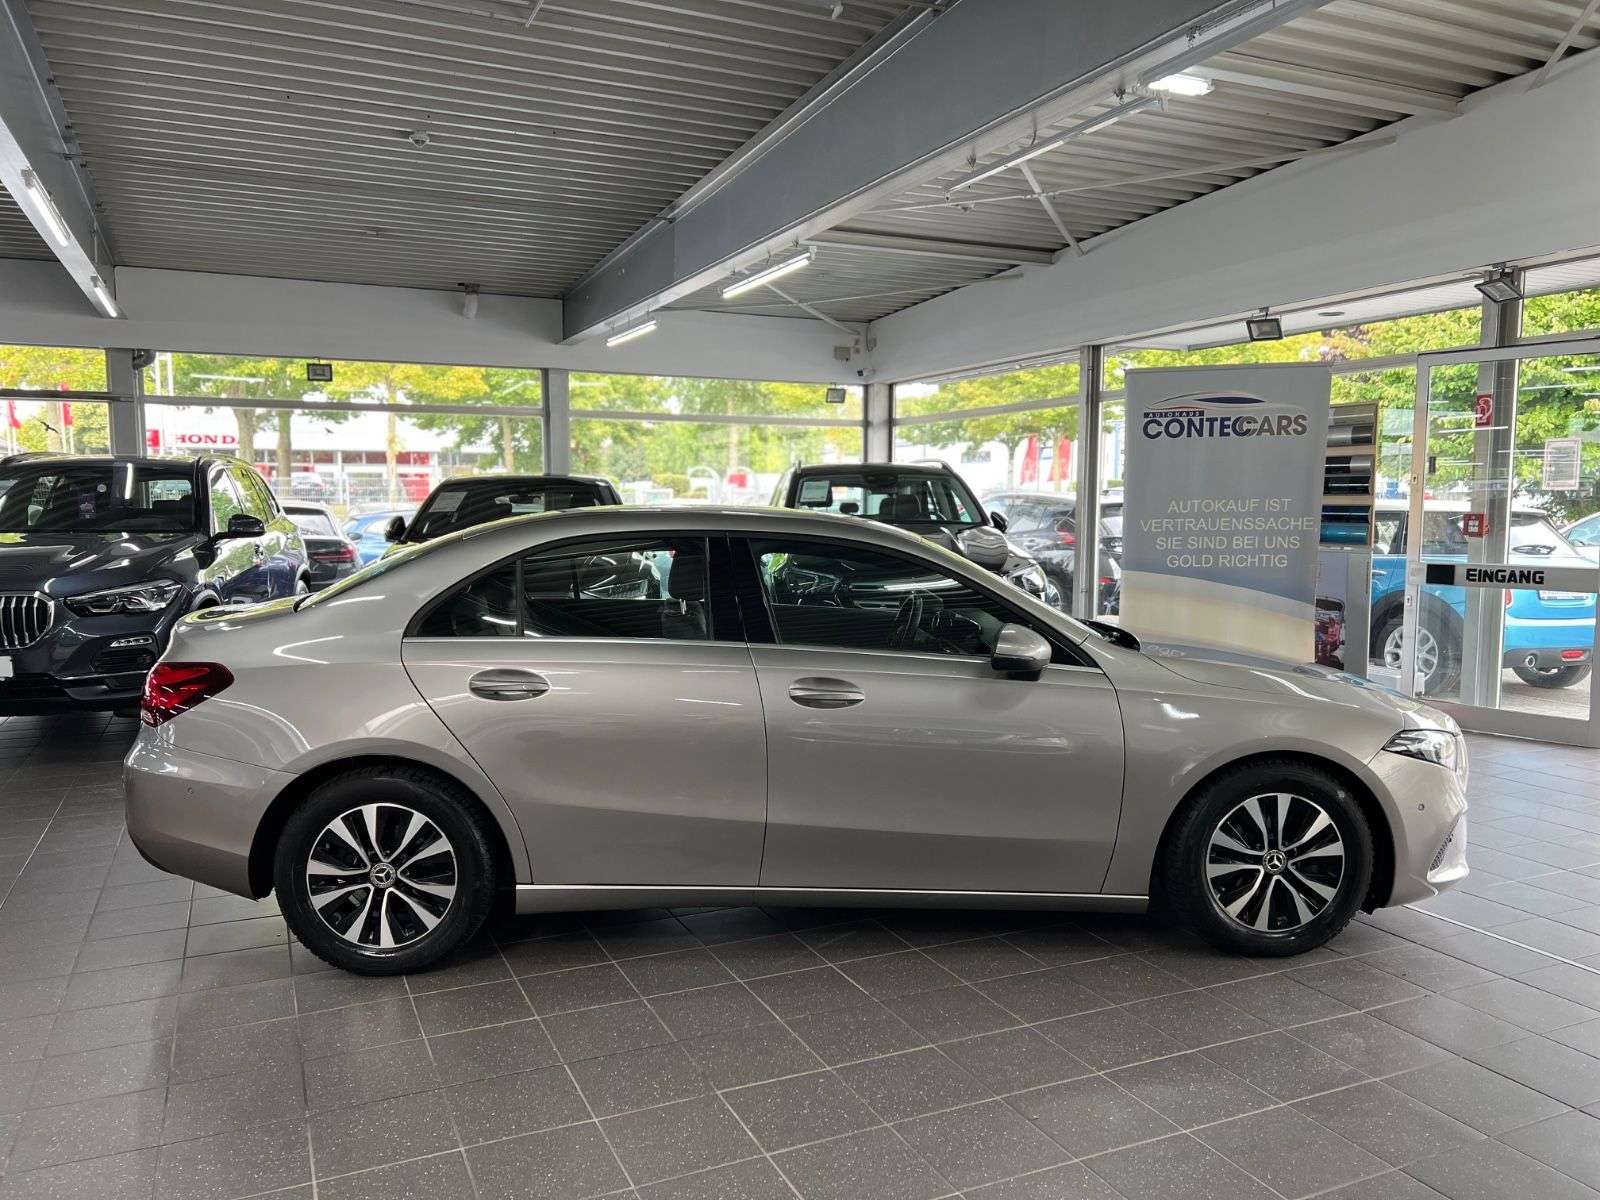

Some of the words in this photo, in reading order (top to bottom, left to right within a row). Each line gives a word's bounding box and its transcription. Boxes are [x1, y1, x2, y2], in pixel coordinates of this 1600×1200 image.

[176, 434, 240, 444] HOND
[1168, 499, 1261, 513] AUTOKAUF
[1265, 499, 1292, 512] IST
[1156, 536, 1184, 550] SIE
[1187, 536, 1227, 549] SIND
[1233, 536, 1258, 549] BEI
[1264, 535, 1300, 549] UNS
[1166, 554, 1213, 568] GOLD
[1218, 554, 1288, 567] RICHTIG
[1466, 568, 1544, 584] EINGANG
